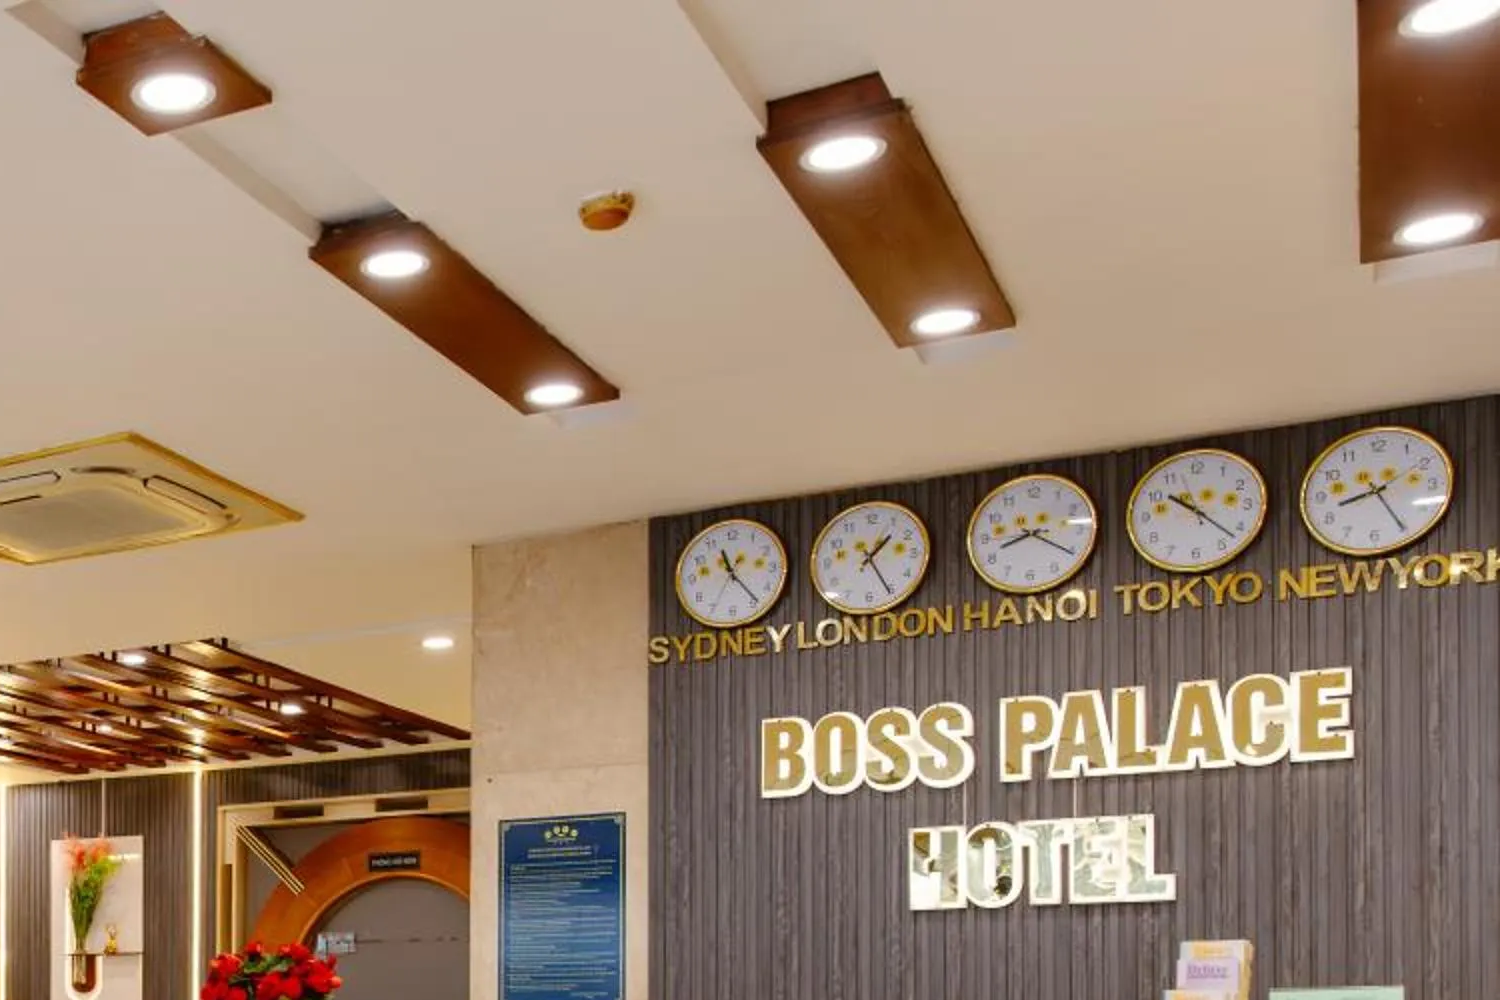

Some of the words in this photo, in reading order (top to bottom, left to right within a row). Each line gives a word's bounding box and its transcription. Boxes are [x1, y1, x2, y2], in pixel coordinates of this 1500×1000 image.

[648, 624, 791, 663] SYDNEY
[797, 607, 954, 649] LONDON
[963, 589, 1097, 630] HANOI
[1114, 572, 1263, 614] TOKYO
[761, 702, 974, 799] BOSS
[1000, 666, 1354, 783] PALACE
[908, 813, 1177, 911] HOTEL
